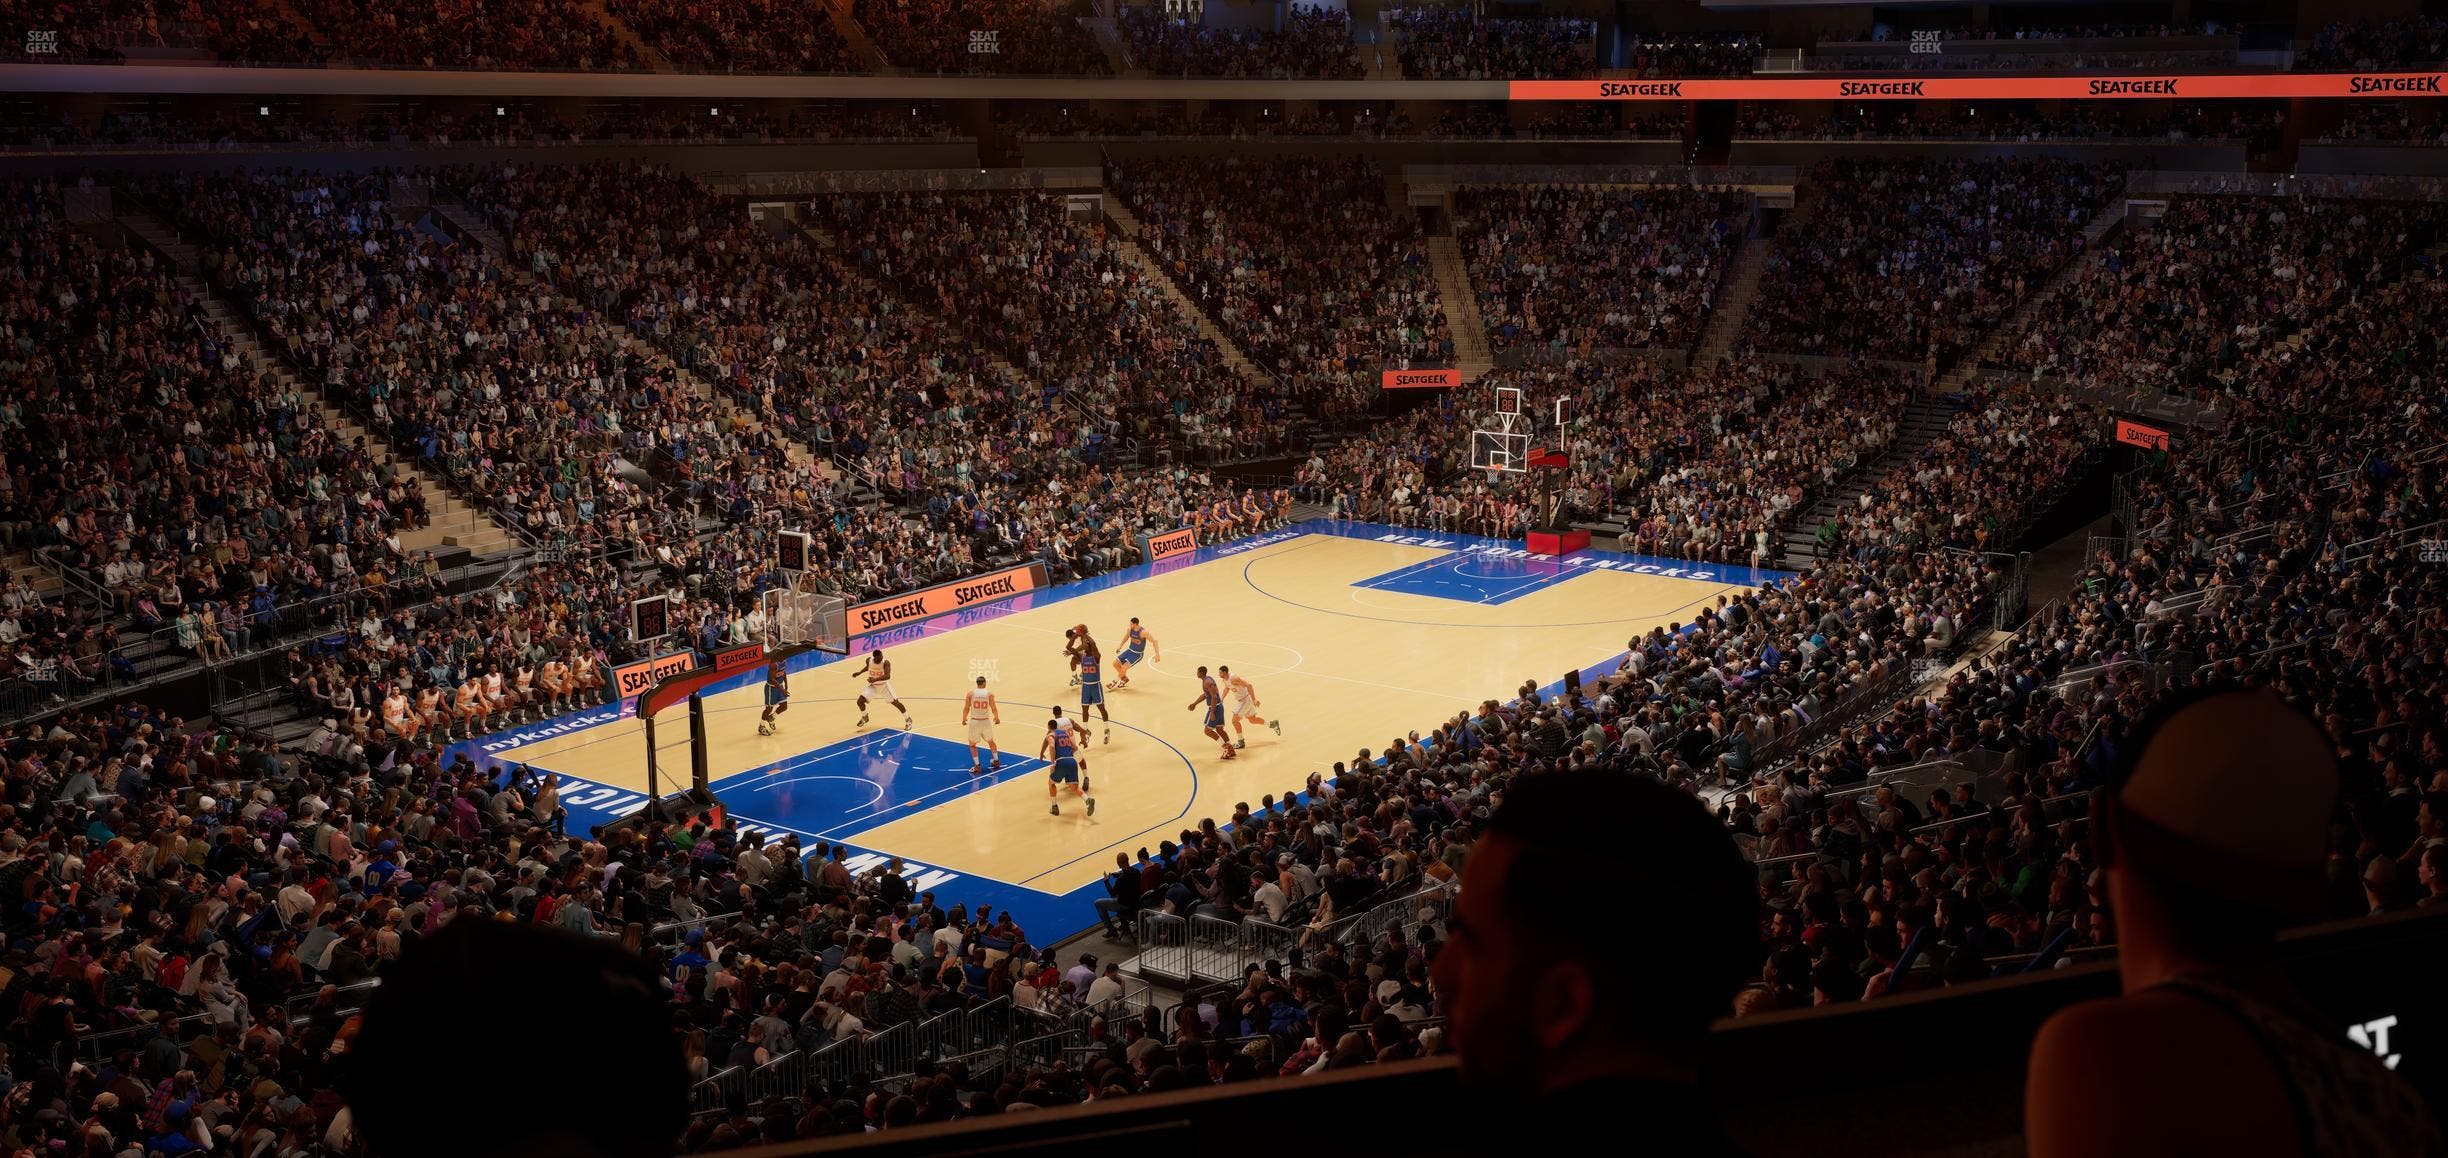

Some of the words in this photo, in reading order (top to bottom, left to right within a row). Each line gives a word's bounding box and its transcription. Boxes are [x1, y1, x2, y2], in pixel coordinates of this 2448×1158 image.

[1600, 82, 1682, 97] SEATGEEK
[1839, 81, 1924, 96] SEATGEEK
[2089, 78, 2178, 95] SEATGEEK
[2350, 75, 2442, 93] SEATGEEK
[1396, 374, 1448, 386] SEATGEEK
[1152, 533, 1193, 556] SEATGEEK
[1375, 534, 1456, 548] NEW
[1563, 556, 1716, 580] KNICKS
[861, 597, 927, 630] SEATGEEK
[955, 575, 1015, 605] SEATGEEK
[720, 648, 758, 667] SEATGEEK
[973, 701, 988, 709] 00
[481, 706, 637, 751] nyknicks.c
